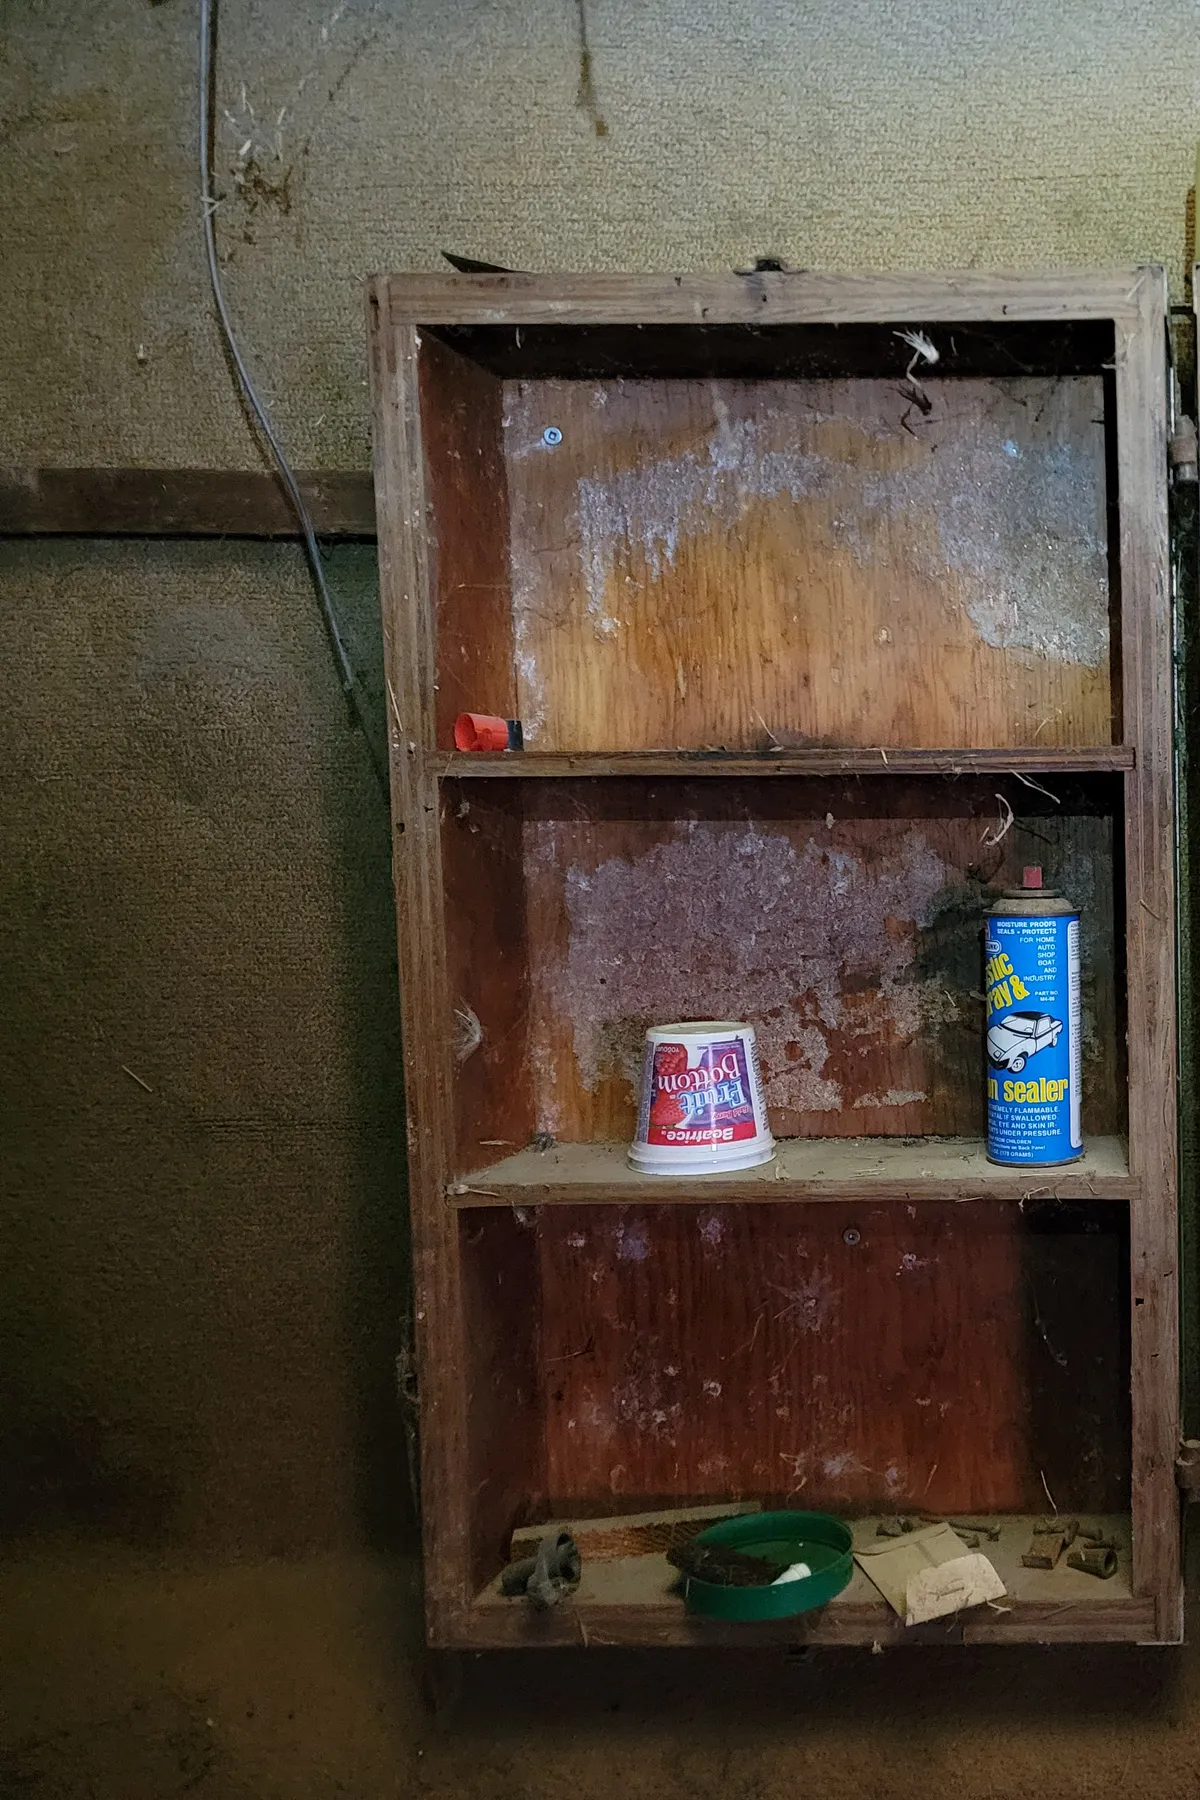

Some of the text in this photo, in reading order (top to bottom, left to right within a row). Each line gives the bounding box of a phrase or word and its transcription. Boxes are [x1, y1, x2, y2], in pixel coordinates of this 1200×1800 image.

[658, 1053, 741, 1092] Bottom
[677, 1078, 748, 1116] Fruit
[1003, 1077, 1068, 1103] sealer
[667, 1127, 734, 1144] Beatrice
